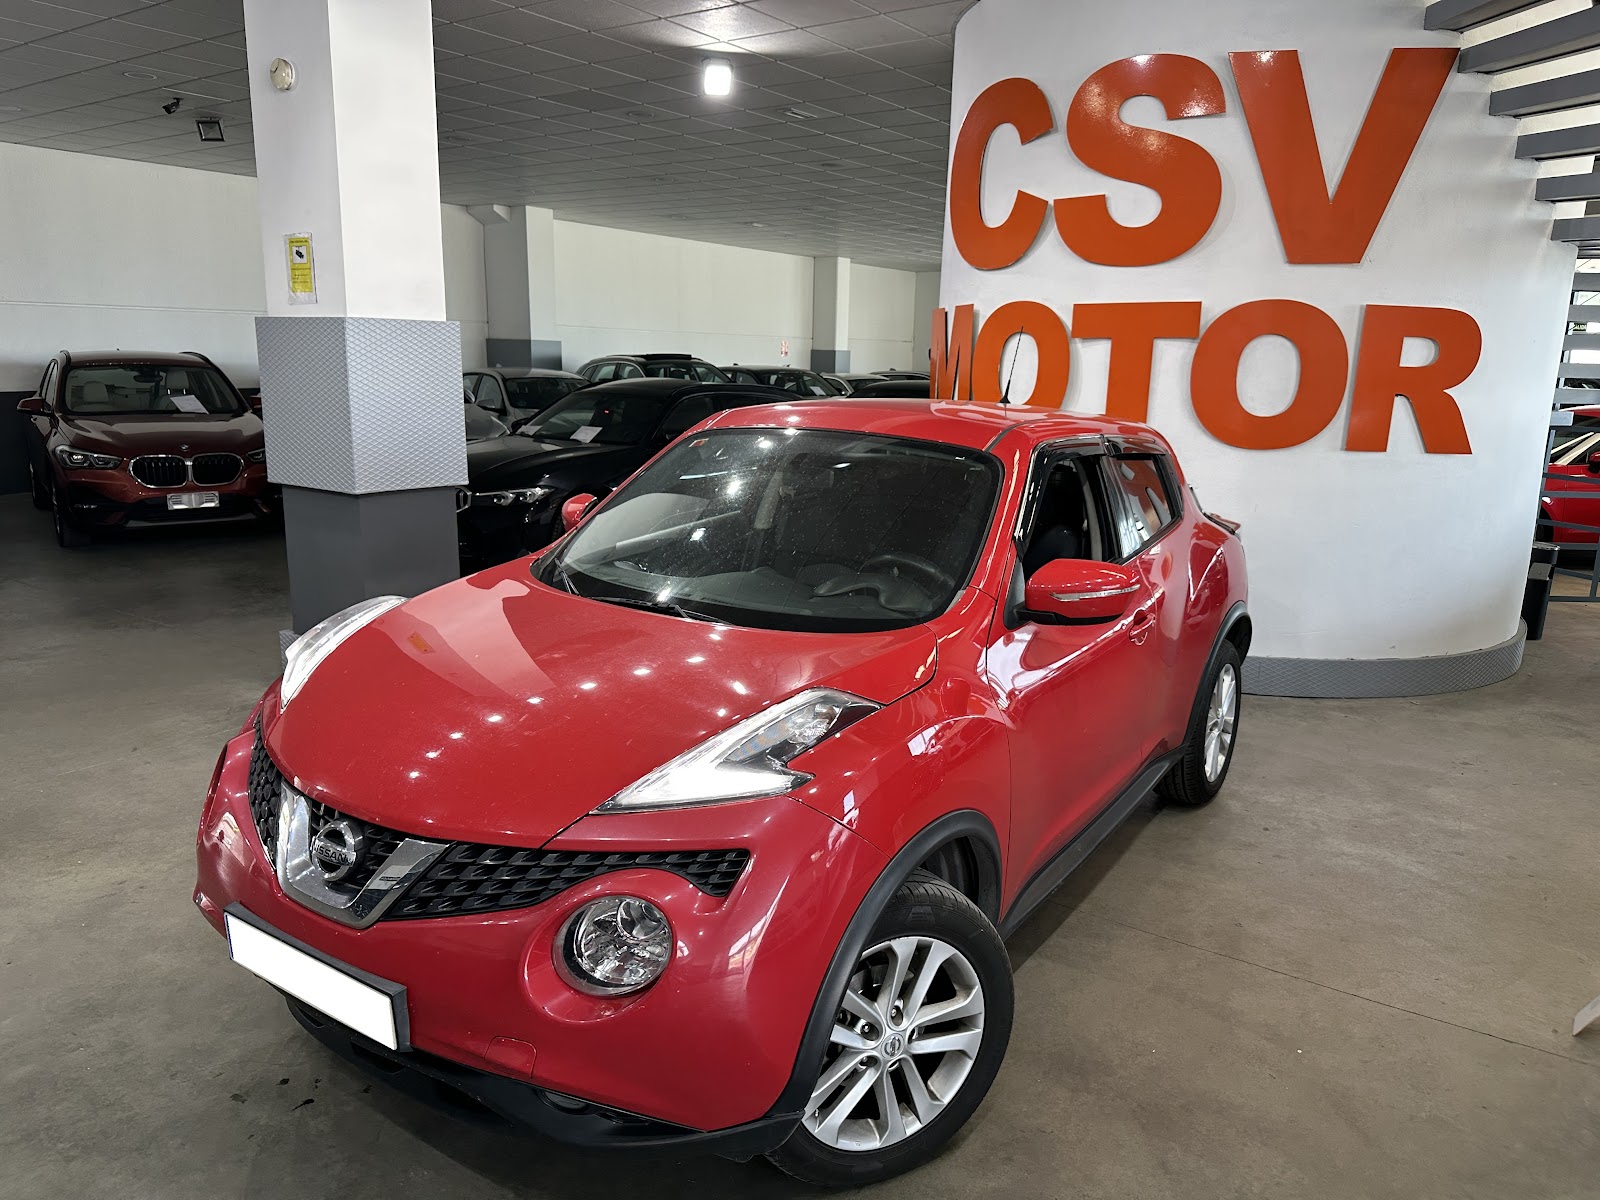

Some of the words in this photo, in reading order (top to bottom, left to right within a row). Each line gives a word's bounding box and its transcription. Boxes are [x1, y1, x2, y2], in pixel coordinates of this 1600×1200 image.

[949, 47, 1460, 271] CSV
[930, 298, 1482, 455] MOTOR
[314, 842, 347, 863] NISSAN
